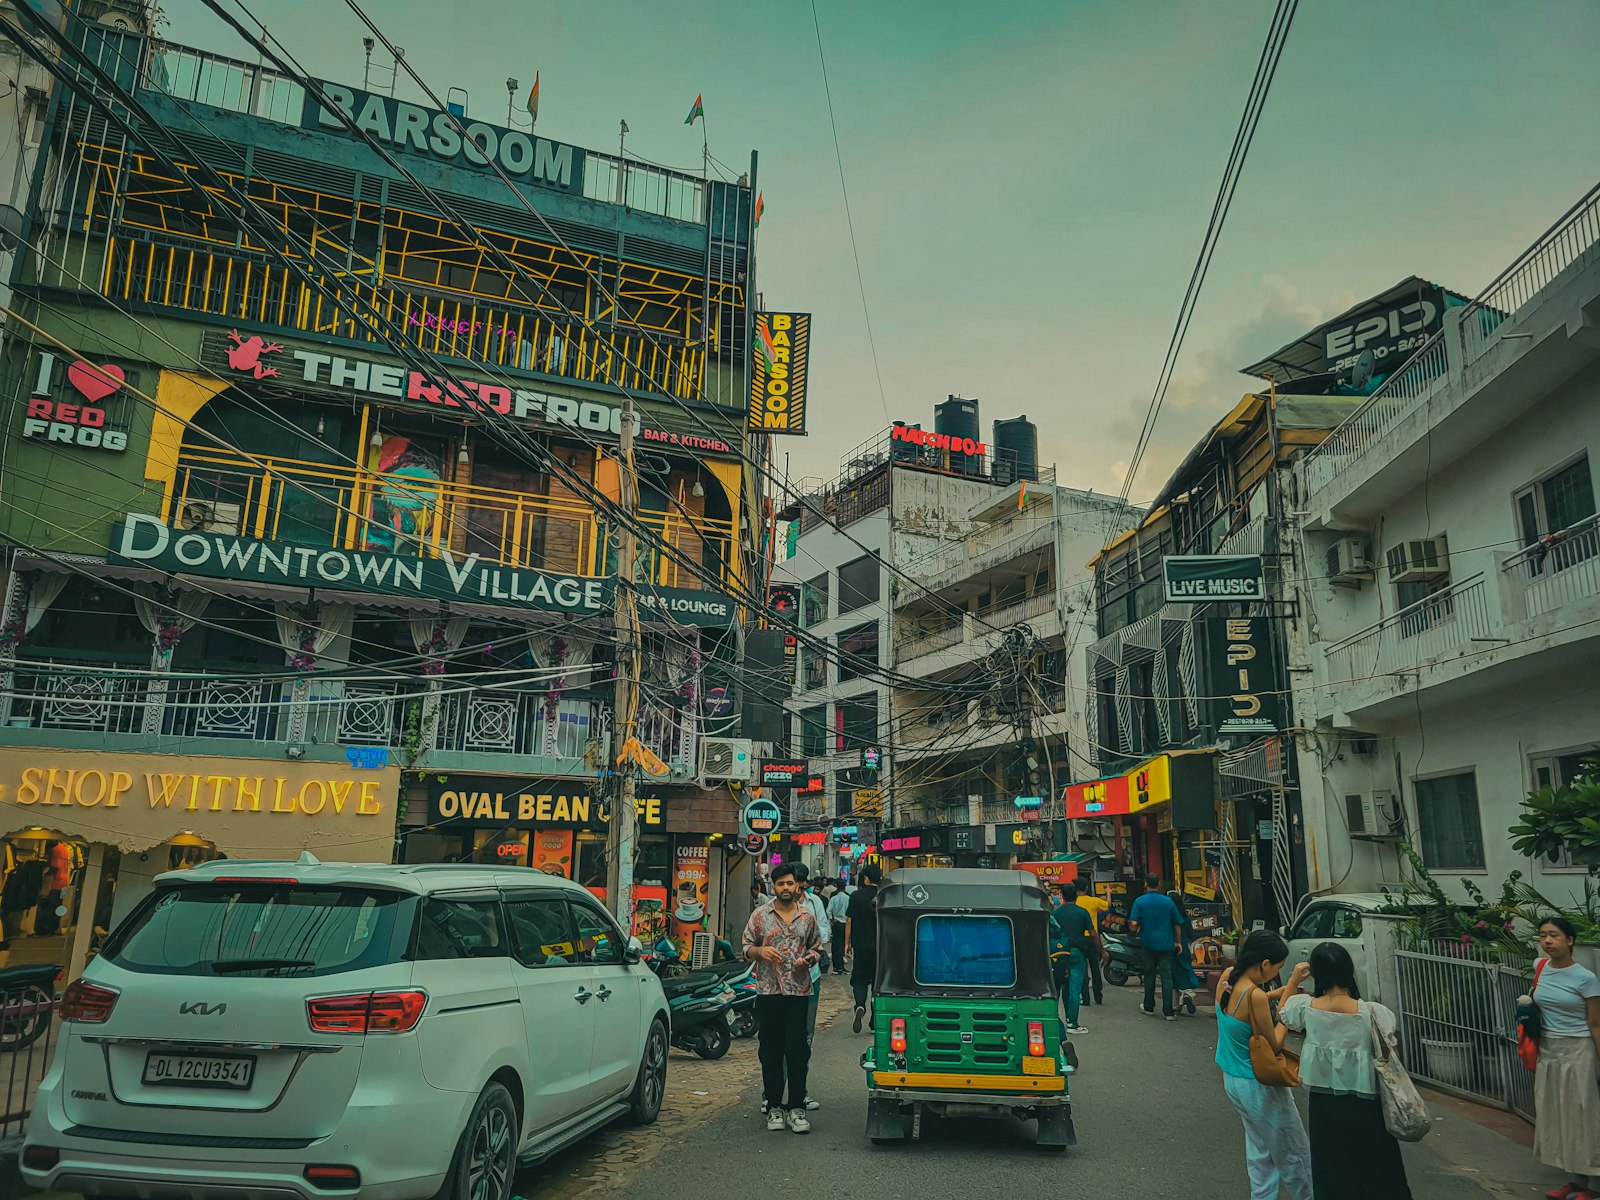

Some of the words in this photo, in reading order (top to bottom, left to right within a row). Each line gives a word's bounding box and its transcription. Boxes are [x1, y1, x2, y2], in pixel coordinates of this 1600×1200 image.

[318, 82, 573, 187] BARSOOM
[31, 351, 55, 397] I
[763, 313, 792, 429] BARSOOM
[294, 350, 403, 397] THE
[407, 370, 511, 415] RED
[514, 389, 641, 437] FROG
[26, 398, 106, 428] RED
[23, 417, 128, 452] FROG
[644, 427, 669, 443] BAR
[670, 431, 679, 444] &
[681, 434, 730, 453] KITCHEN
[1172, 578, 1207, 595] LIVE
[1208, 577, 1255, 595] MUSIC
[671, 599, 727, 617] LOUNGE
[763, 762, 803, 774] chicago
[763, 772, 793, 783] pizza
[15, 767, 134, 808] SHOP
[143, 772, 264, 813] WITH
[270, 777, 381, 816] LOVE
[438, 790, 510, 820] OVAL
[517, 793, 590, 822] BEAN
[747, 809, 762, 819] OVAL
[762, 809, 777, 819] BEAN
[497, 840, 527, 857] OPEN
[677, 846, 708, 858] COFFEE
[1036, 865, 1064, 876] WOW!
